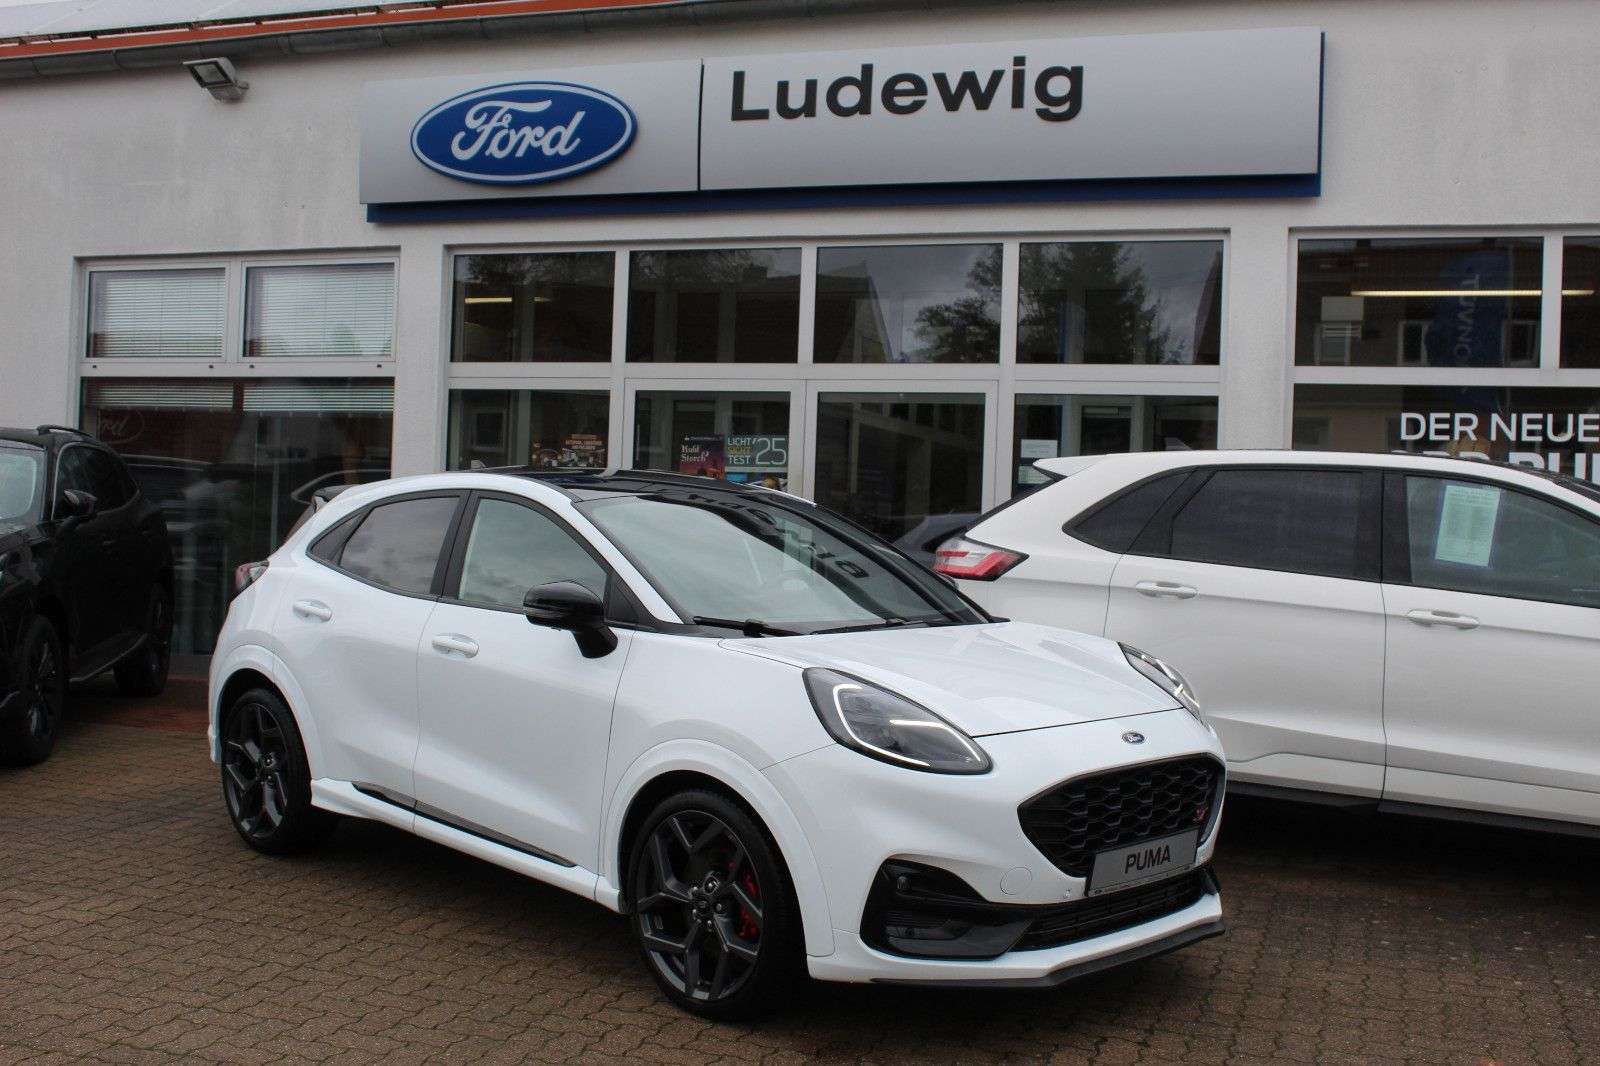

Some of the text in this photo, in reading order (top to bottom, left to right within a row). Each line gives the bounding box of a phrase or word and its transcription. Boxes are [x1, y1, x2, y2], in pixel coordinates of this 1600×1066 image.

[731, 55, 1085, 122] Ludewig
[451, 99, 585, 161] Ford
[727, 437, 752, 446] LICHT
[1401, 412, 1600, 443] DER NEUE
[727, 455, 751, 465] TEST
[1125, 844, 1171, 874] PUMA
